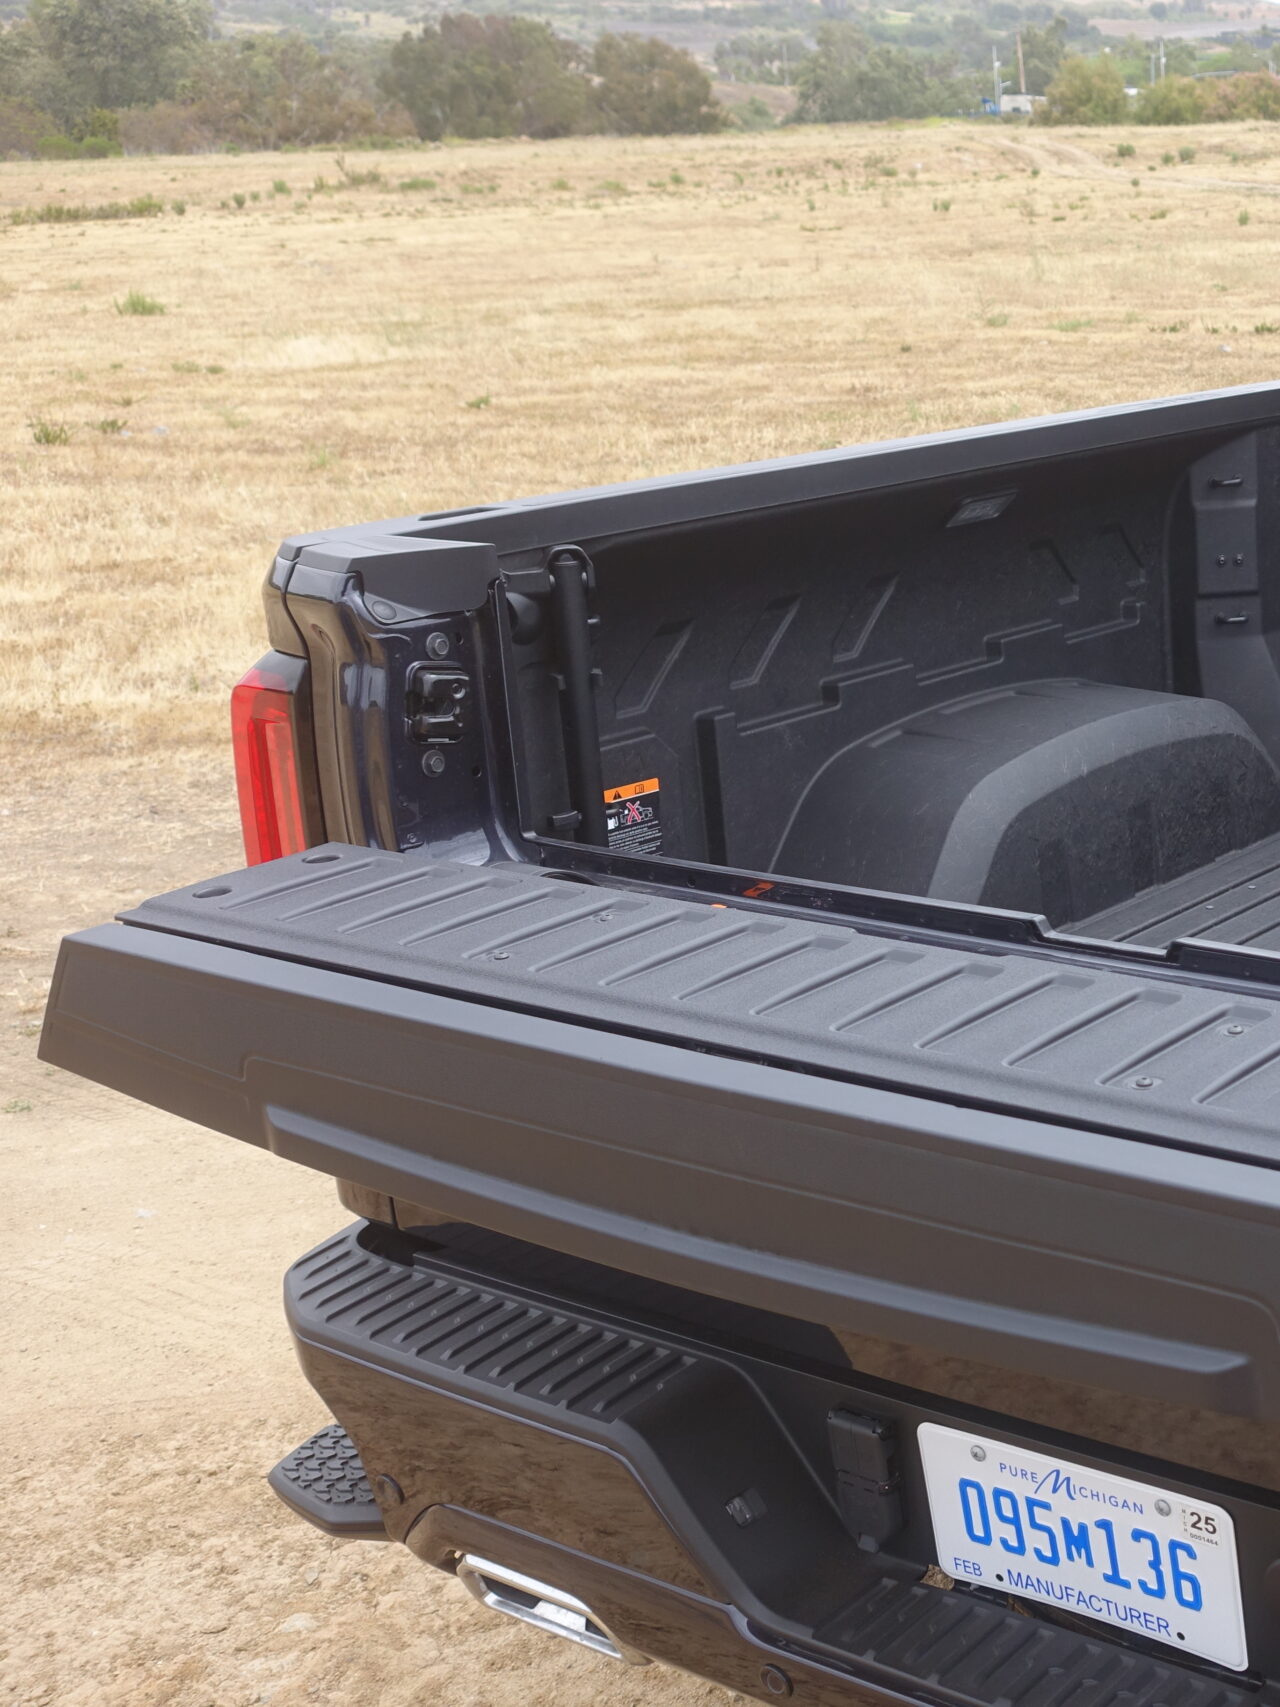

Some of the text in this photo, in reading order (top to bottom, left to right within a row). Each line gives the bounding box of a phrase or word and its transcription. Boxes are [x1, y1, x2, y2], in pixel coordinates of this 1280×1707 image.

[999, 1462, 1144, 1515] PURE MICHIGAN
[958, 1477, 1203, 1612] 095M136
[1189, 1511, 1217, 1535] 25
[953, 1557, 983, 1578] FEB
[1006, 1568, 1173, 1638] MANUFACTURER
